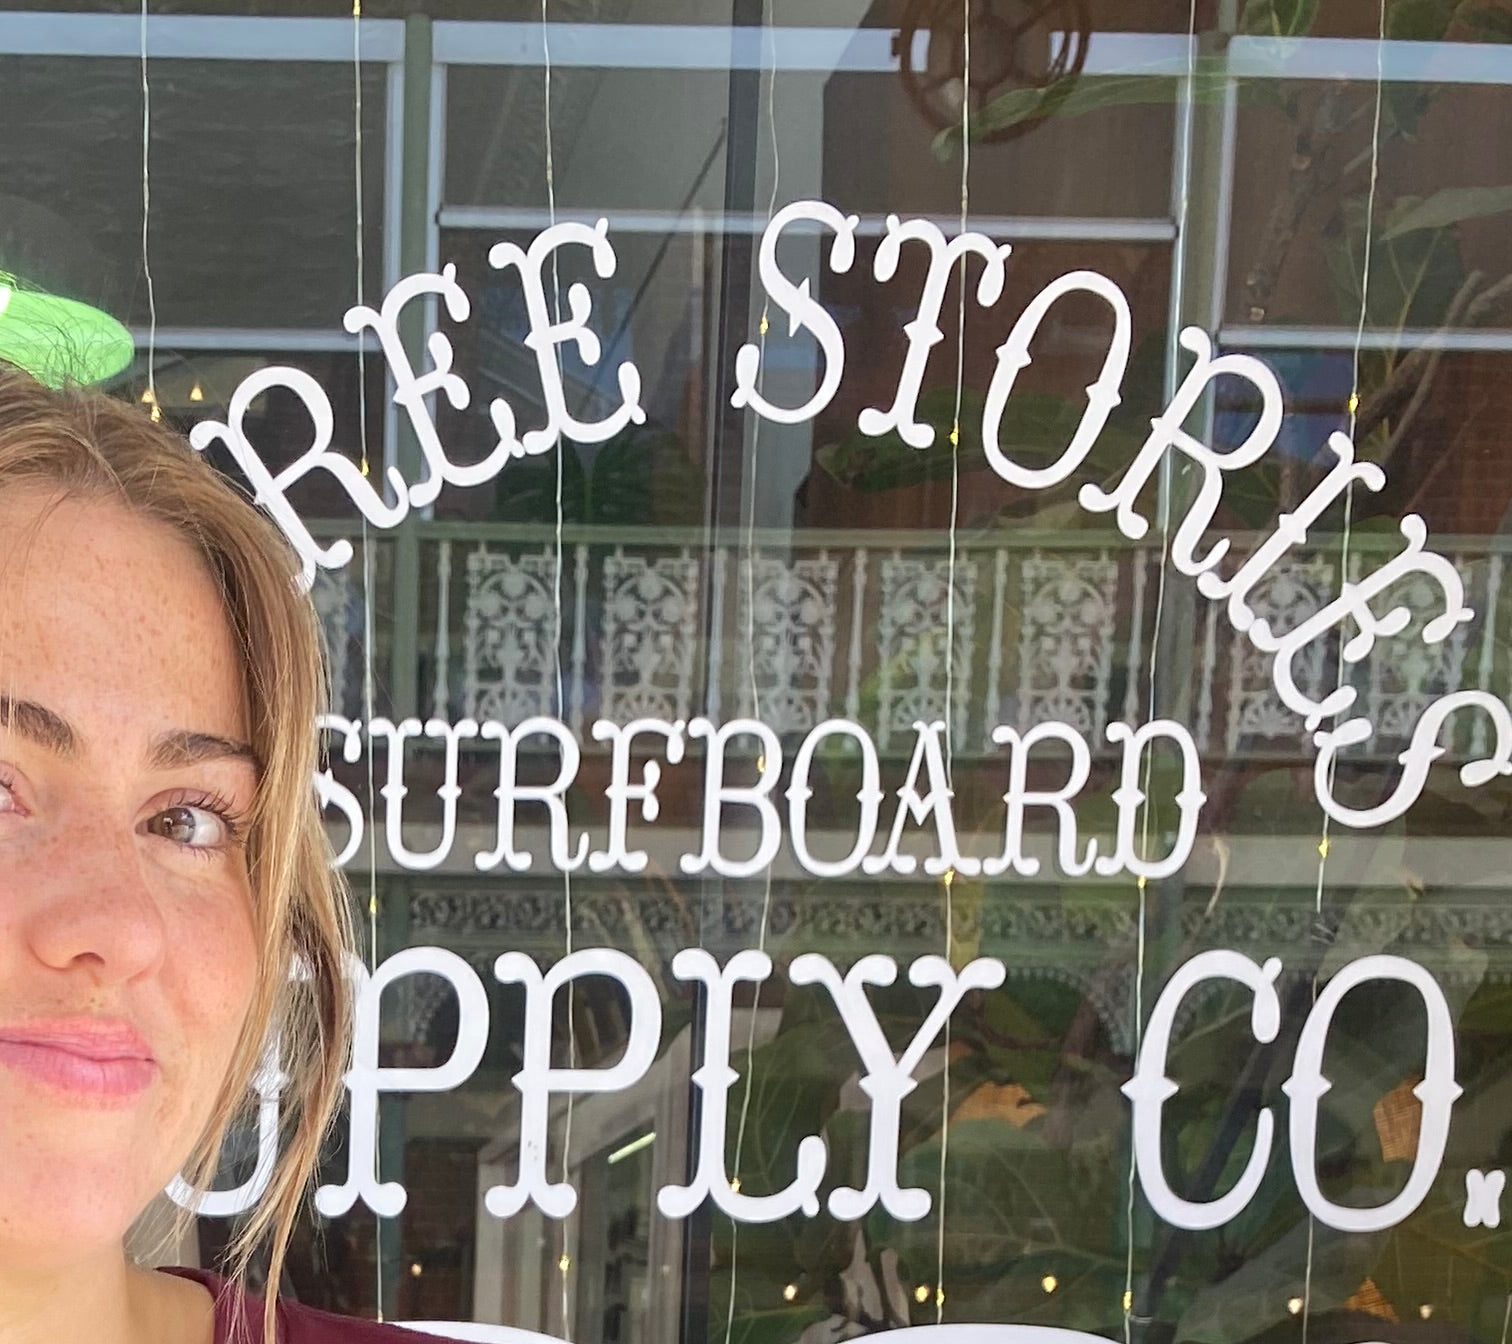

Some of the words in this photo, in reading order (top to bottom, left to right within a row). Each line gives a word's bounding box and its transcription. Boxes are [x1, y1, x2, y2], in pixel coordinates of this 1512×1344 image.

[188, 216, 646, 592] REE
[730, 200, 1512, 828] STORIES
[312, 714, 1208, 879] SURFBOARD
[164, 946, 1006, 1221] UPPLY
[1120, 949, 1506, 1231] CO.
